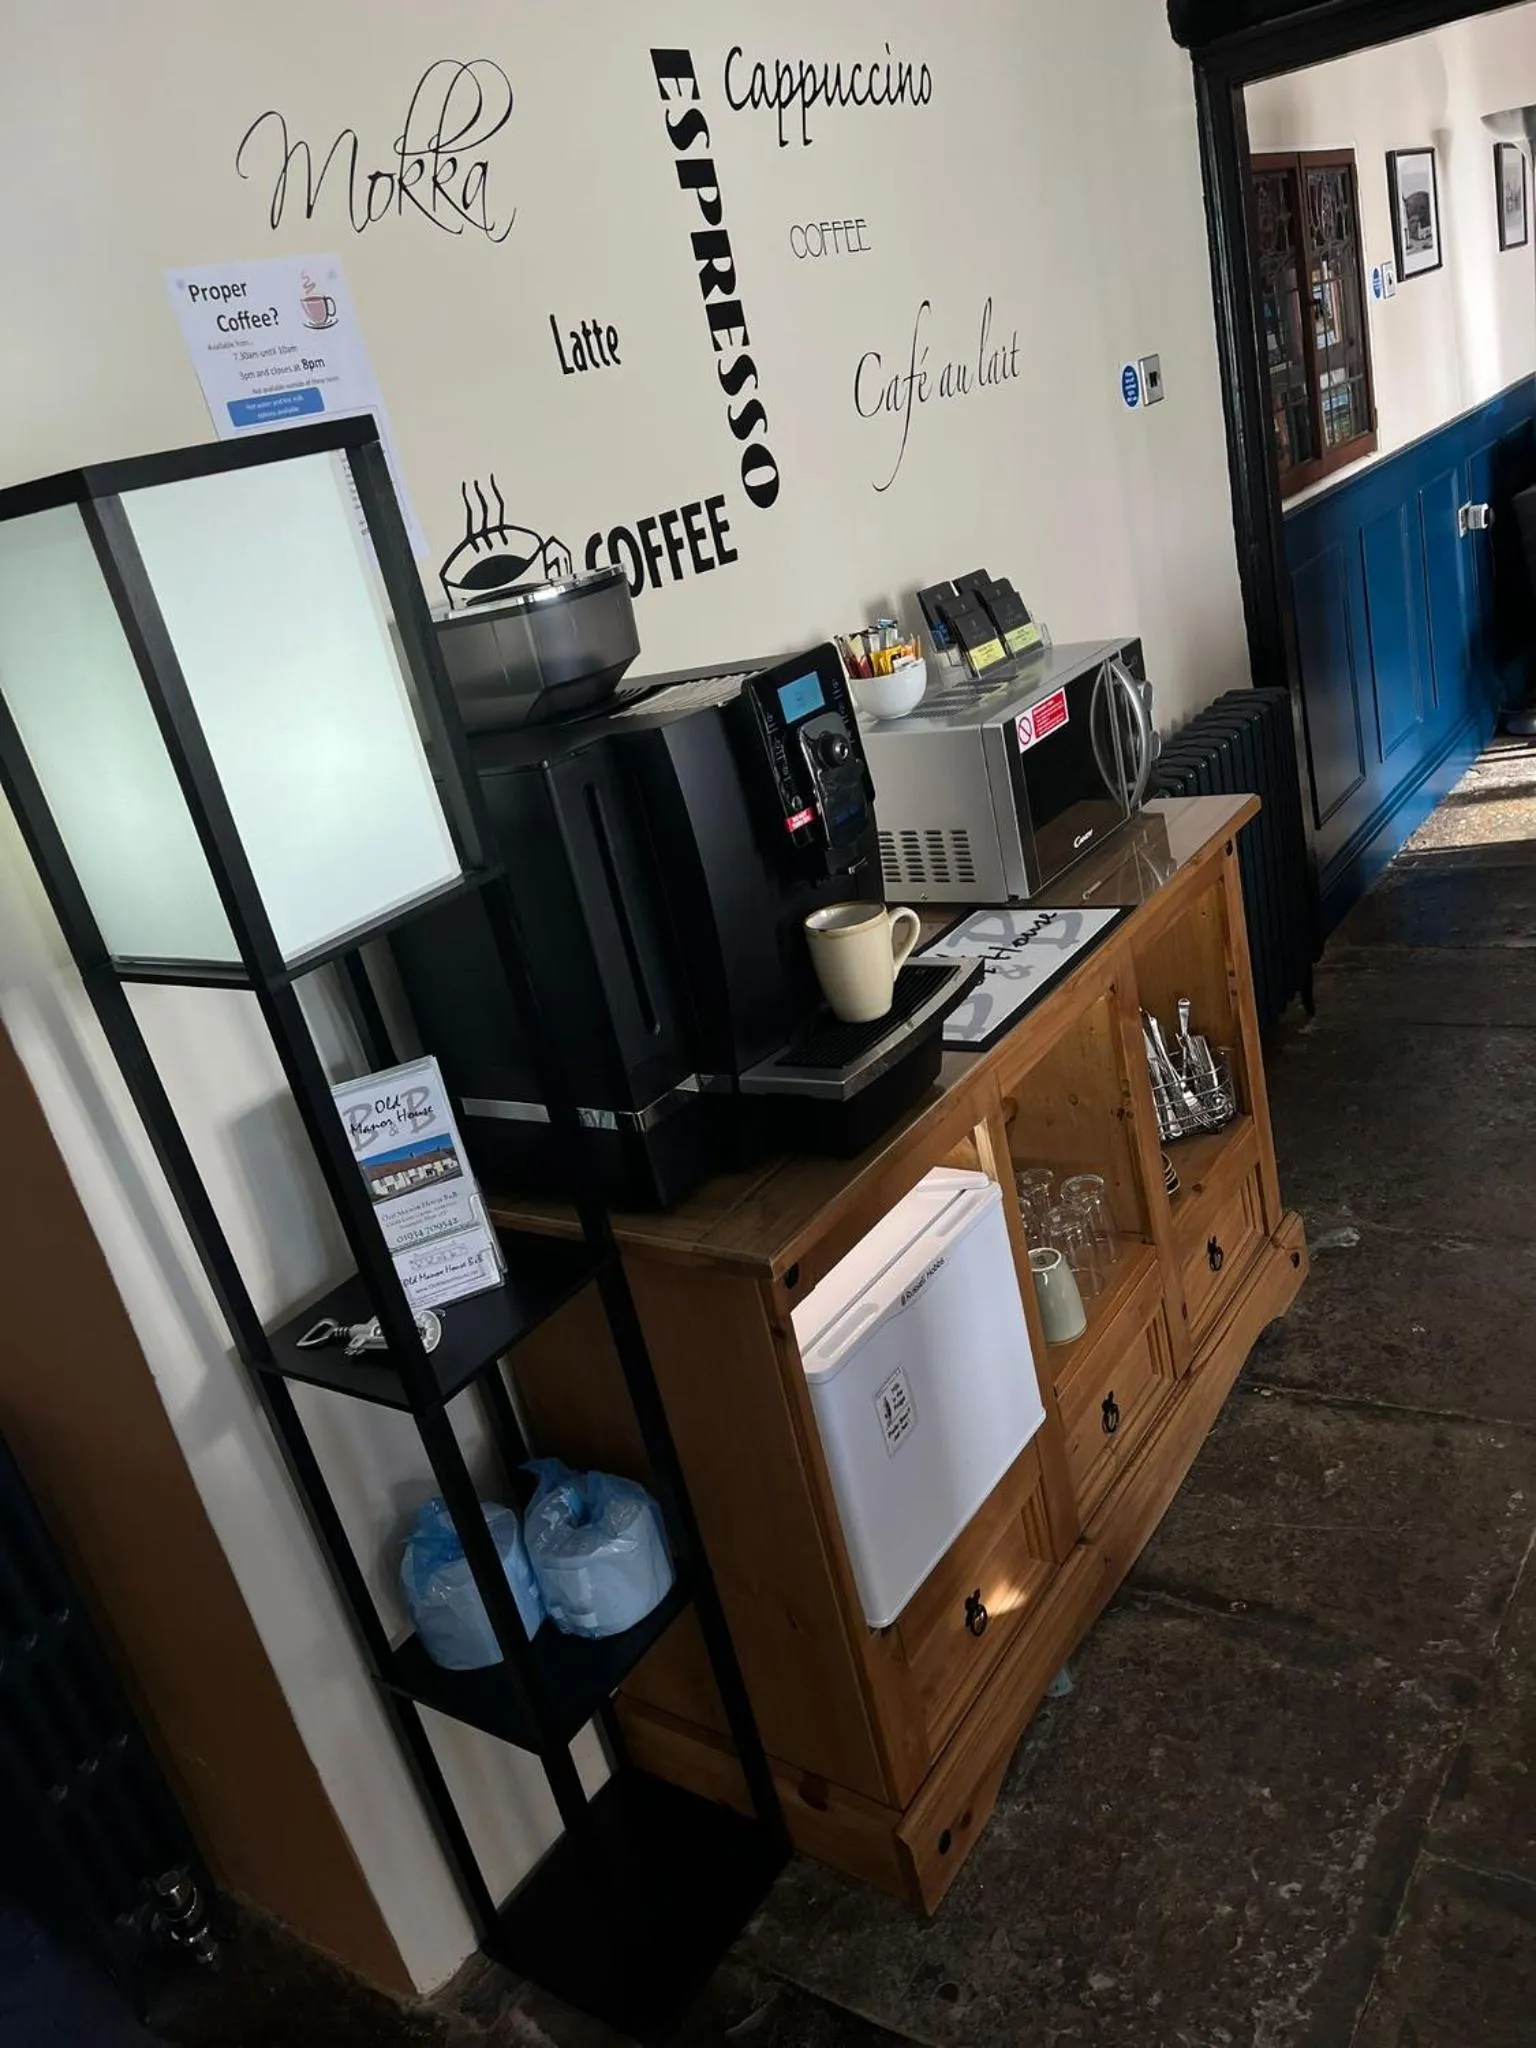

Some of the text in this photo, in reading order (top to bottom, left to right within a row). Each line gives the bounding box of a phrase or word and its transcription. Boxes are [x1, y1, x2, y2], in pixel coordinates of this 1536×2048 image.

[725, 43, 932, 147] Cappuccino
[236, 58, 516, 243] Mokka
[789, 218, 872, 259] COFFEE
[188, 281, 248, 303] Proper
[650, 49, 780, 509] ESPRESSO
[216, 307, 280, 333] Coffee?
[549, 313, 622, 375] Latte
[256, 368, 269, 377] and
[301, 355, 325, 371] 8pm
[854, 300, 934, 492] Café
[939, 362, 974, 398] au
[978, 296, 1021, 387] lait
[350, 1105, 435, 1137] Manor House
[374, 1094, 401, 1114] Old
